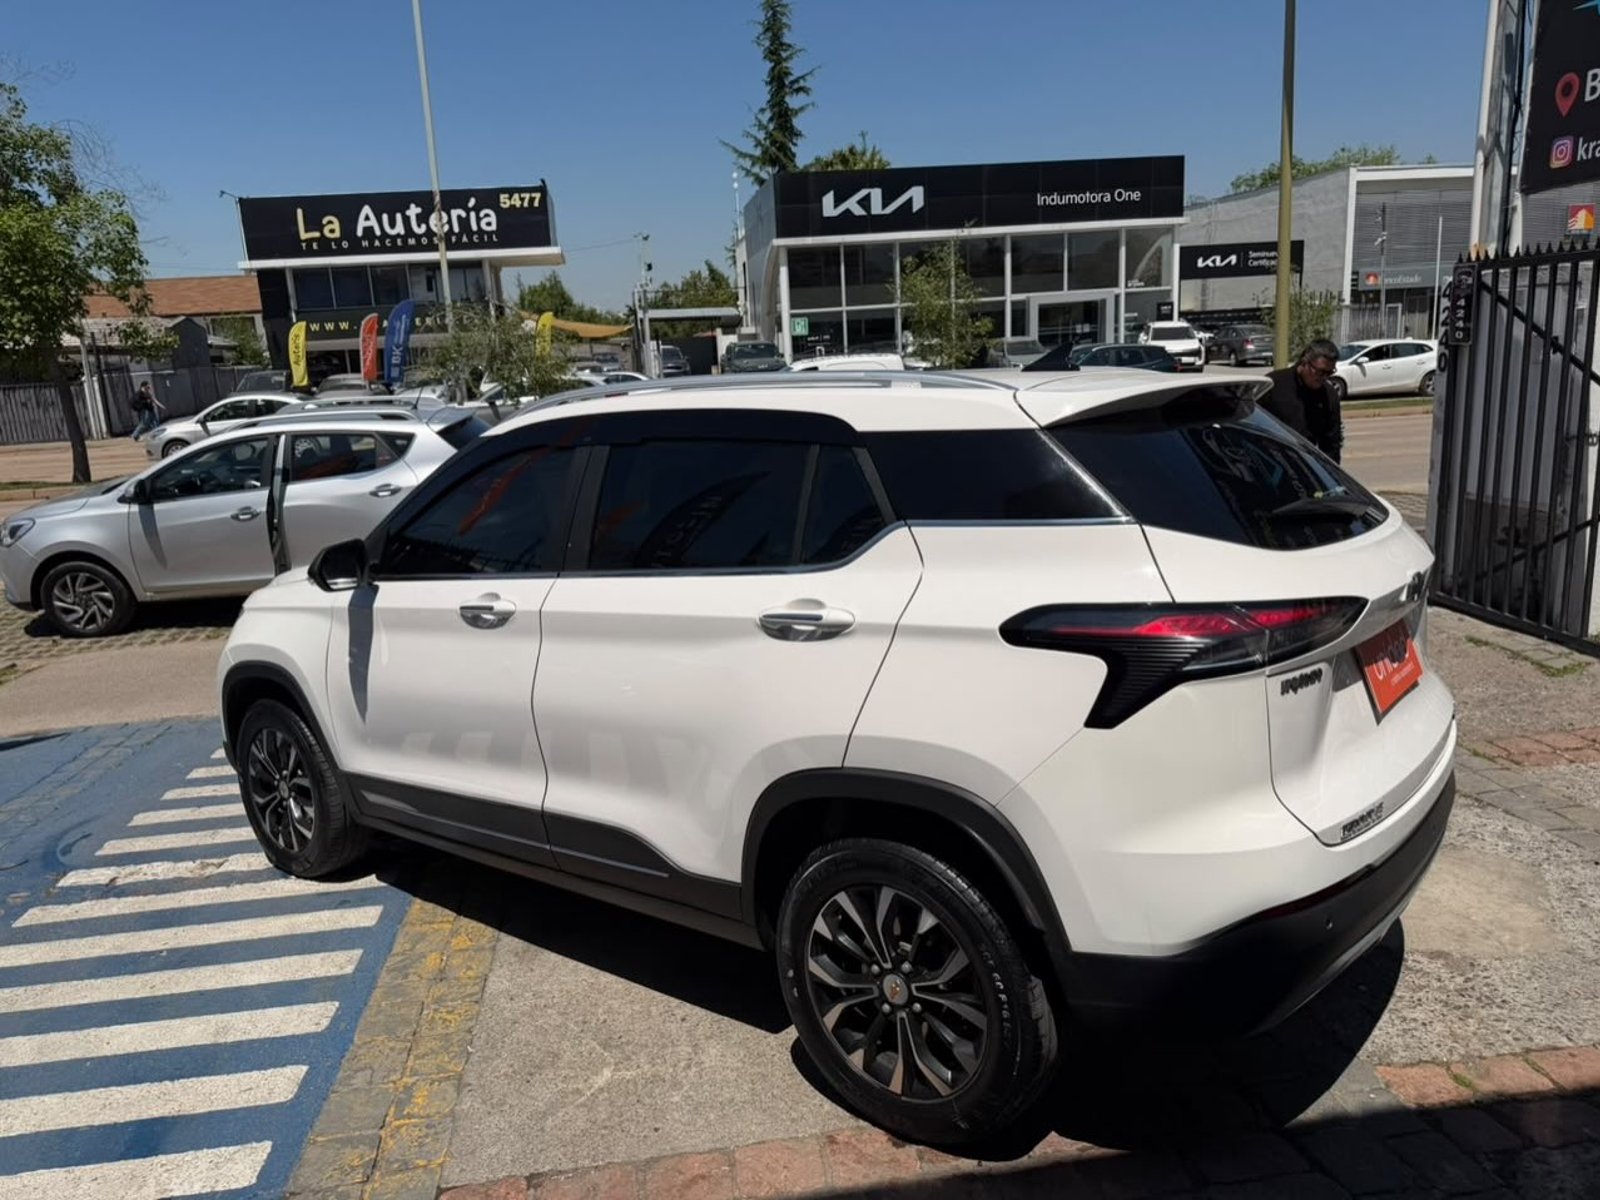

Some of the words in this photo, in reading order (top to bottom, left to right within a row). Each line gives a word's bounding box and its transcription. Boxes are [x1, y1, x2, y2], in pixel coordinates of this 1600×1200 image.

[499, 192, 541, 209] 5477
[822, 185, 924, 218] KIA
[1036, 190, 1111, 206] Indumotora
[1114, 188, 1141, 203] One
[296, 207, 341, 240] La
[356, 197, 497, 237] Autería
[301, 242, 319, 250] TE
[331, 240, 349, 249] LO
[362, 236, 439, 248] HACEMOS
[1196, 254, 1238, 269] KIA
[1454, 298, 1466, 340] 4240
